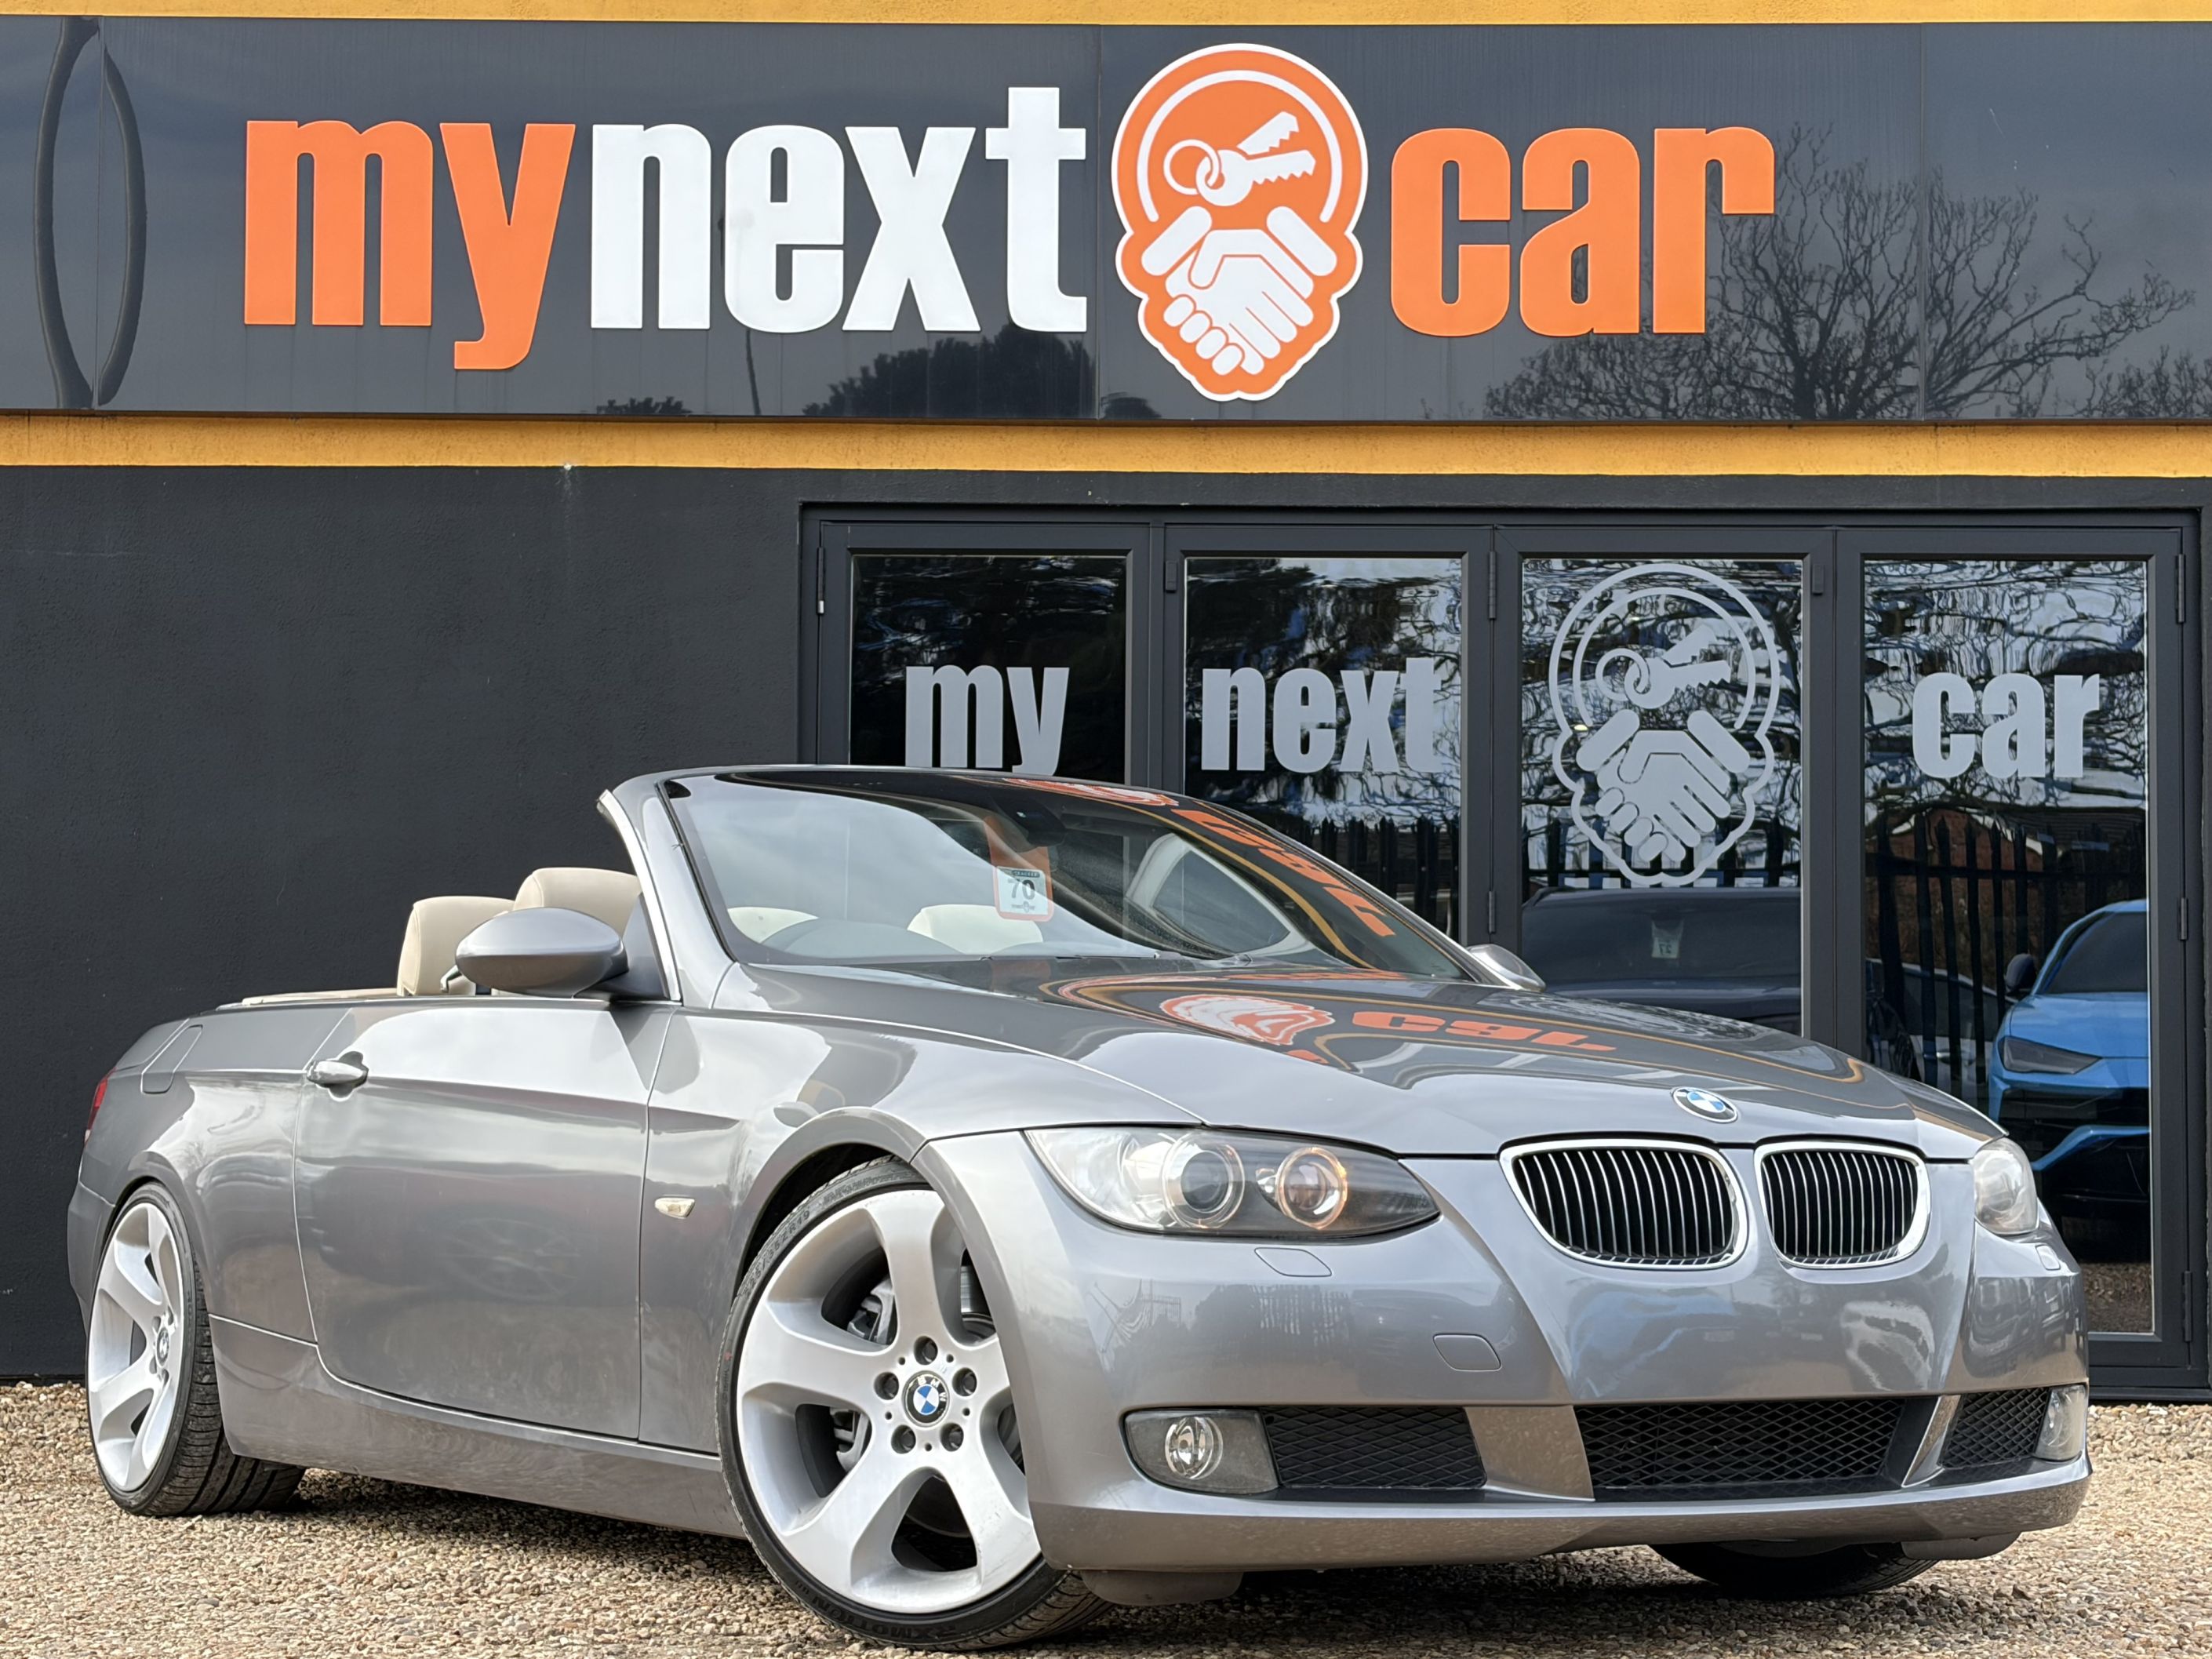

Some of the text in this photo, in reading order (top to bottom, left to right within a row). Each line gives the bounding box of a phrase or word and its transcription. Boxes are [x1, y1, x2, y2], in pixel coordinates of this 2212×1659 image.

[1391, 126, 1774, 337] car
[905, 657, 2101, 779] my next car
[1008, 879, 1035, 900] 70
